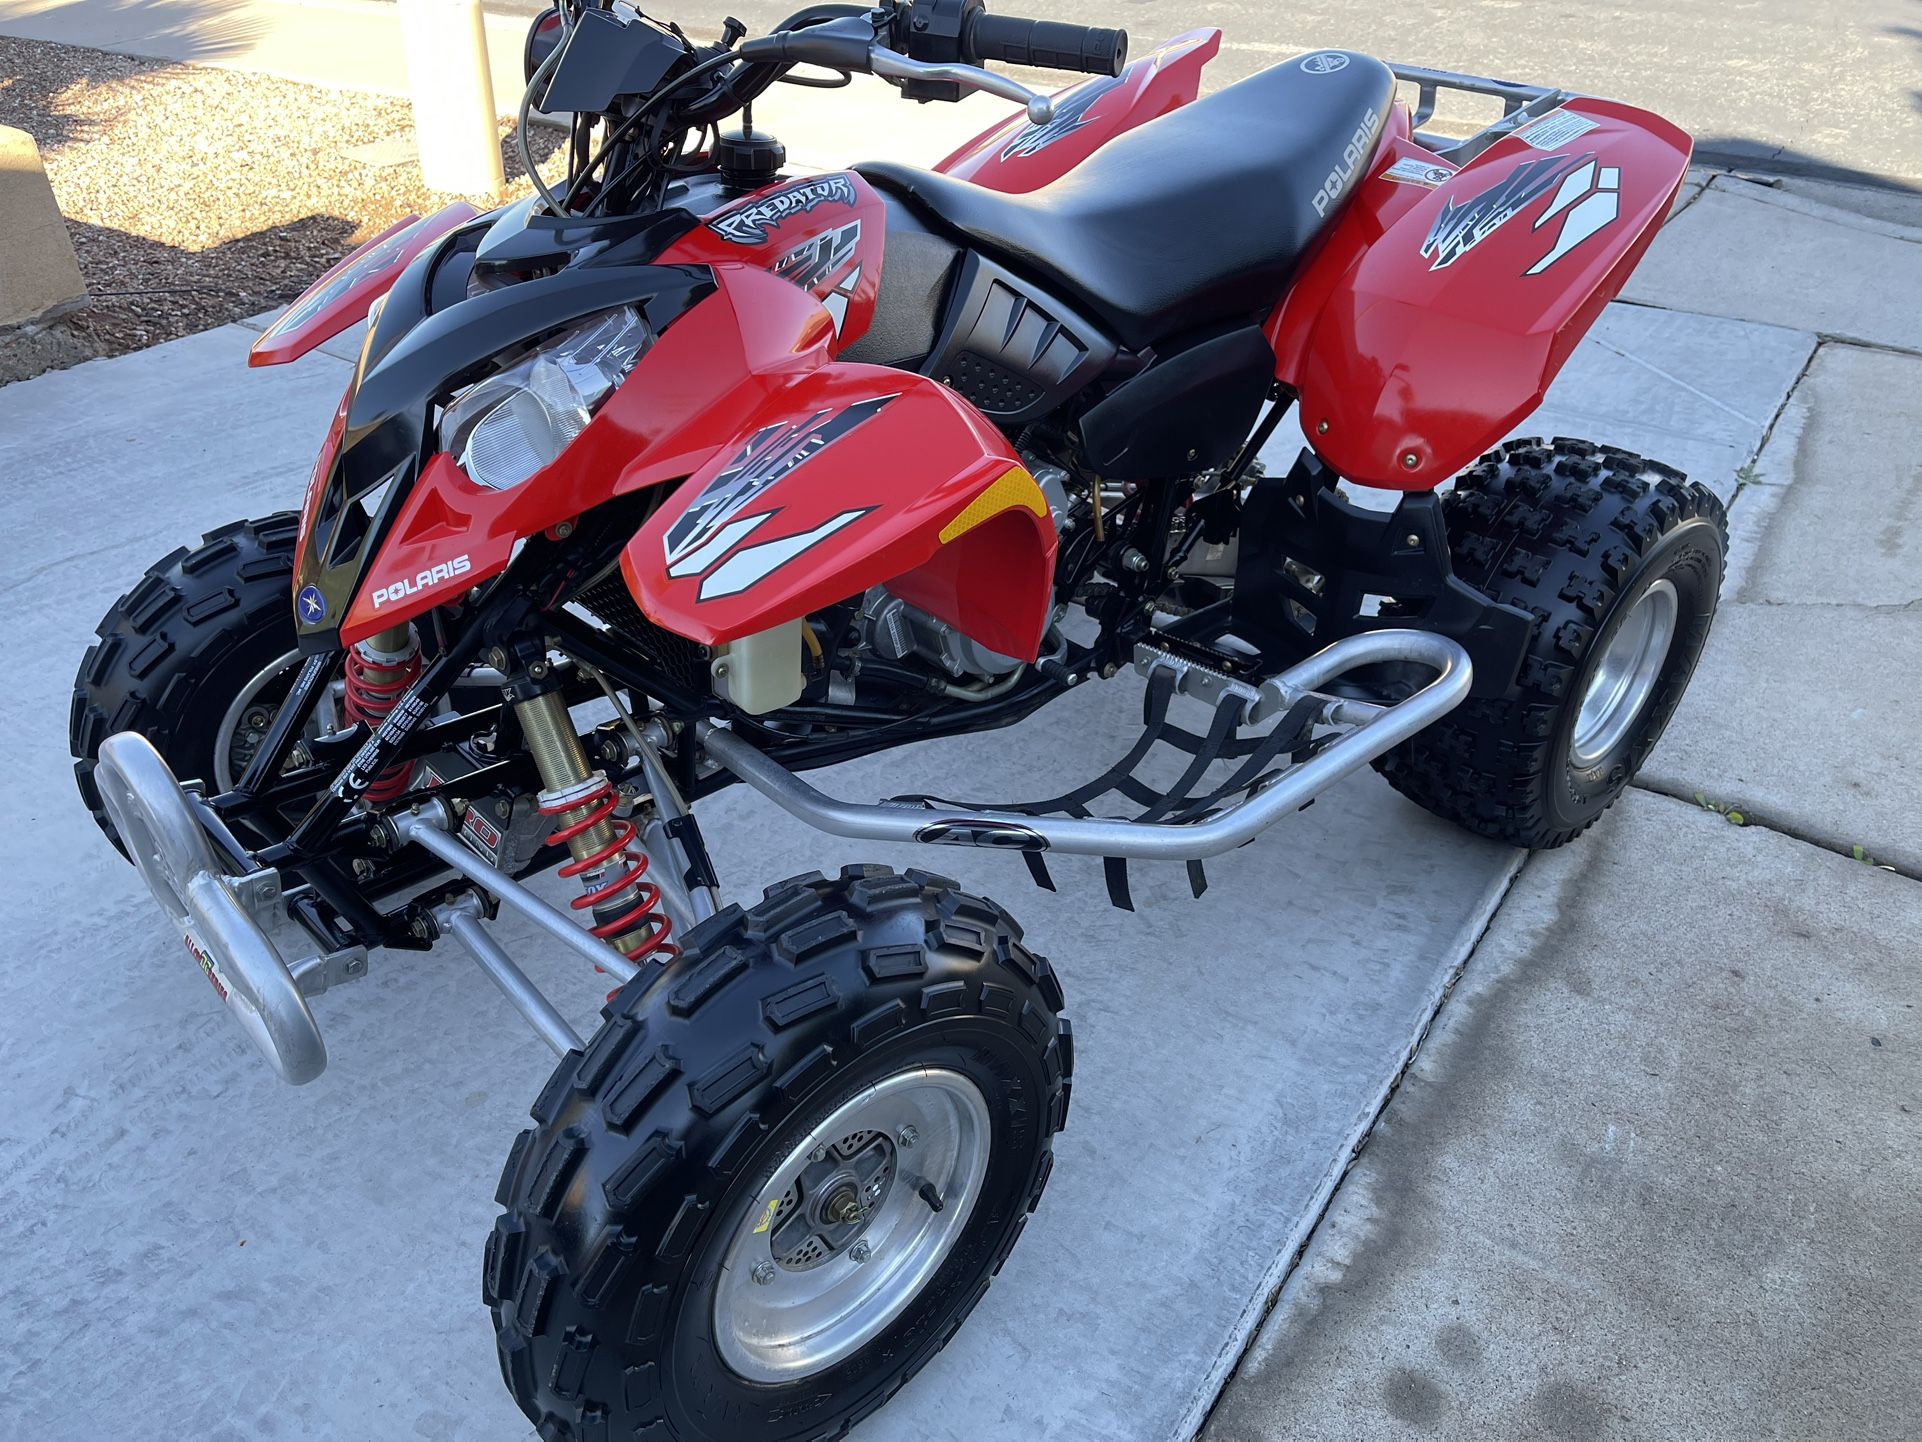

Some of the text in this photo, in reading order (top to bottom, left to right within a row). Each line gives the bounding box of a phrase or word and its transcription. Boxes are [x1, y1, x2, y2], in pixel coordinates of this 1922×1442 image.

[1312, 108, 1380, 218] POLARIS
[709, 176, 853, 242] PREDATOR
[372, 554, 471, 608] POLARIS
